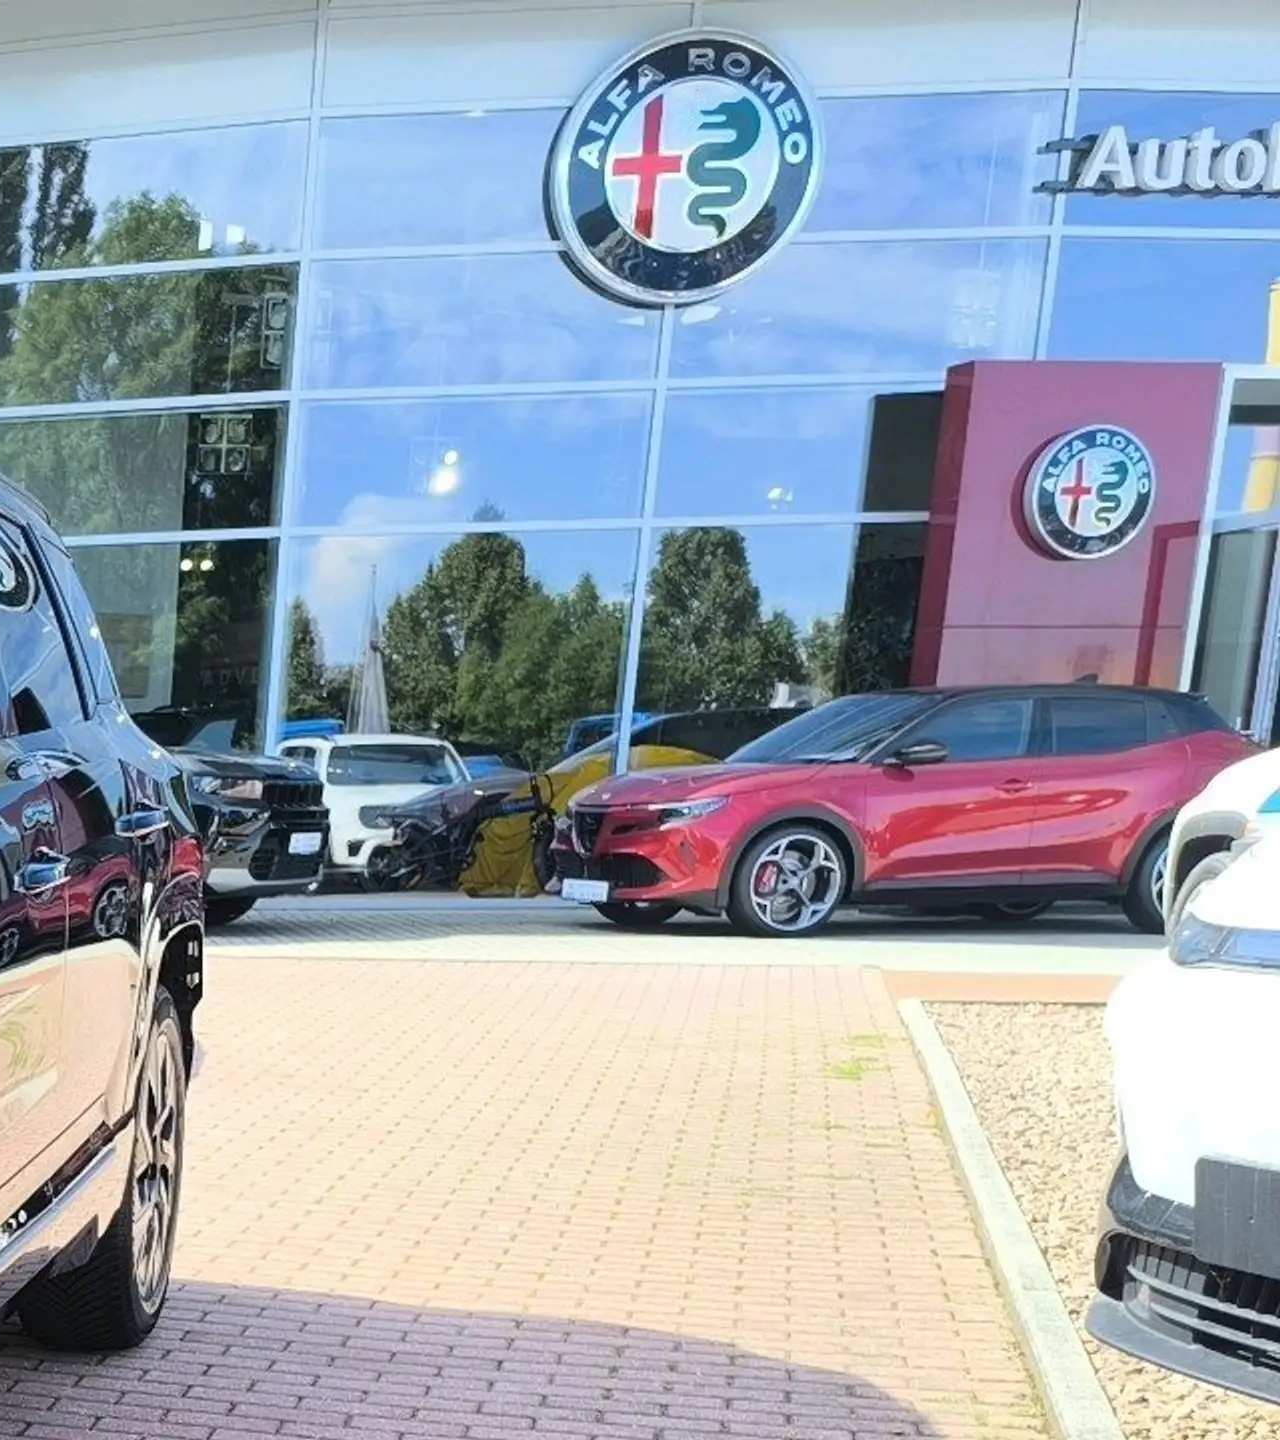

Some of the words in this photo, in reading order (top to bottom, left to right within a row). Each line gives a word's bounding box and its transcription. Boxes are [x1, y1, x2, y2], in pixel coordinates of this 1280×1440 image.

[577, 63, 666, 170] ALFA
[687, 47, 808, 165] ROMEO
[1042, 439, 1087, 494] ALFA
[1095, 431, 1150, 495] ROMEO
